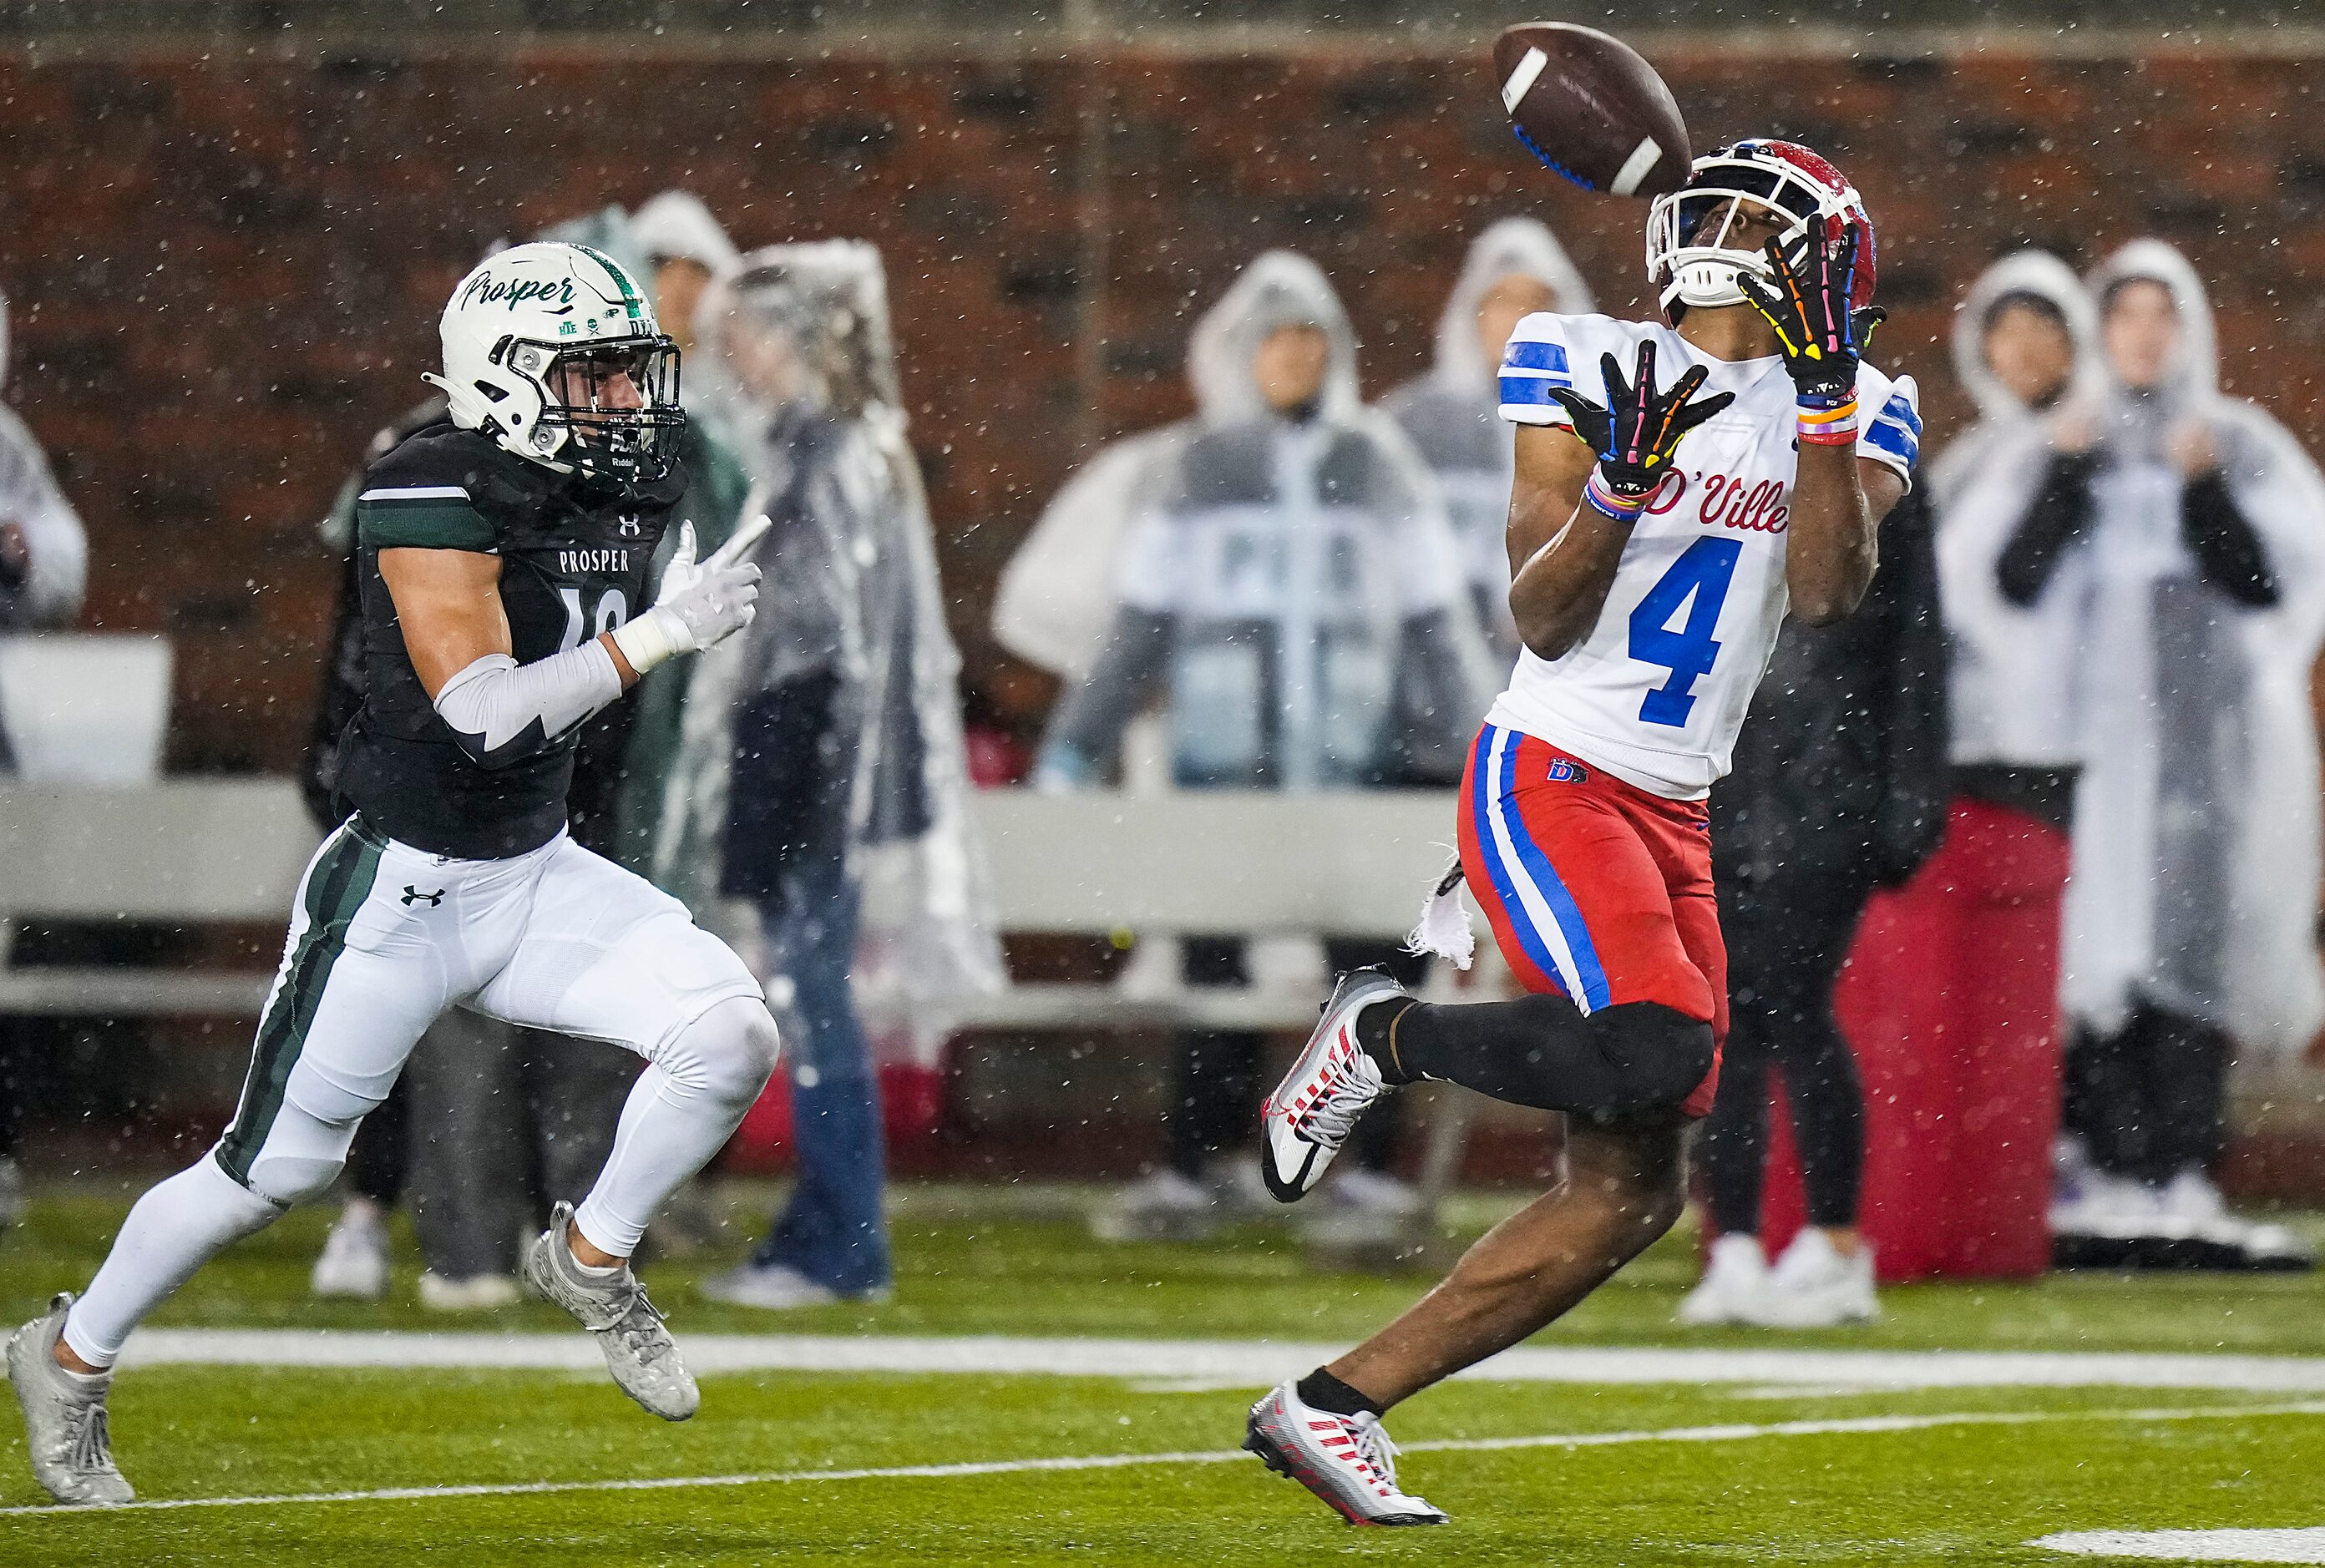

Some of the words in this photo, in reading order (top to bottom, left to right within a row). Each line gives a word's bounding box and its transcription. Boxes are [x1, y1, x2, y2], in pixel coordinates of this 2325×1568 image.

[460, 271, 577, 311] Prosper
[611, 458, 636, 467] Riddel
[1644, 466, 1789, 534] D'Ville
[560, 549, 630, 574] PROSPER
[1628, 534, 1744, 729] 4
